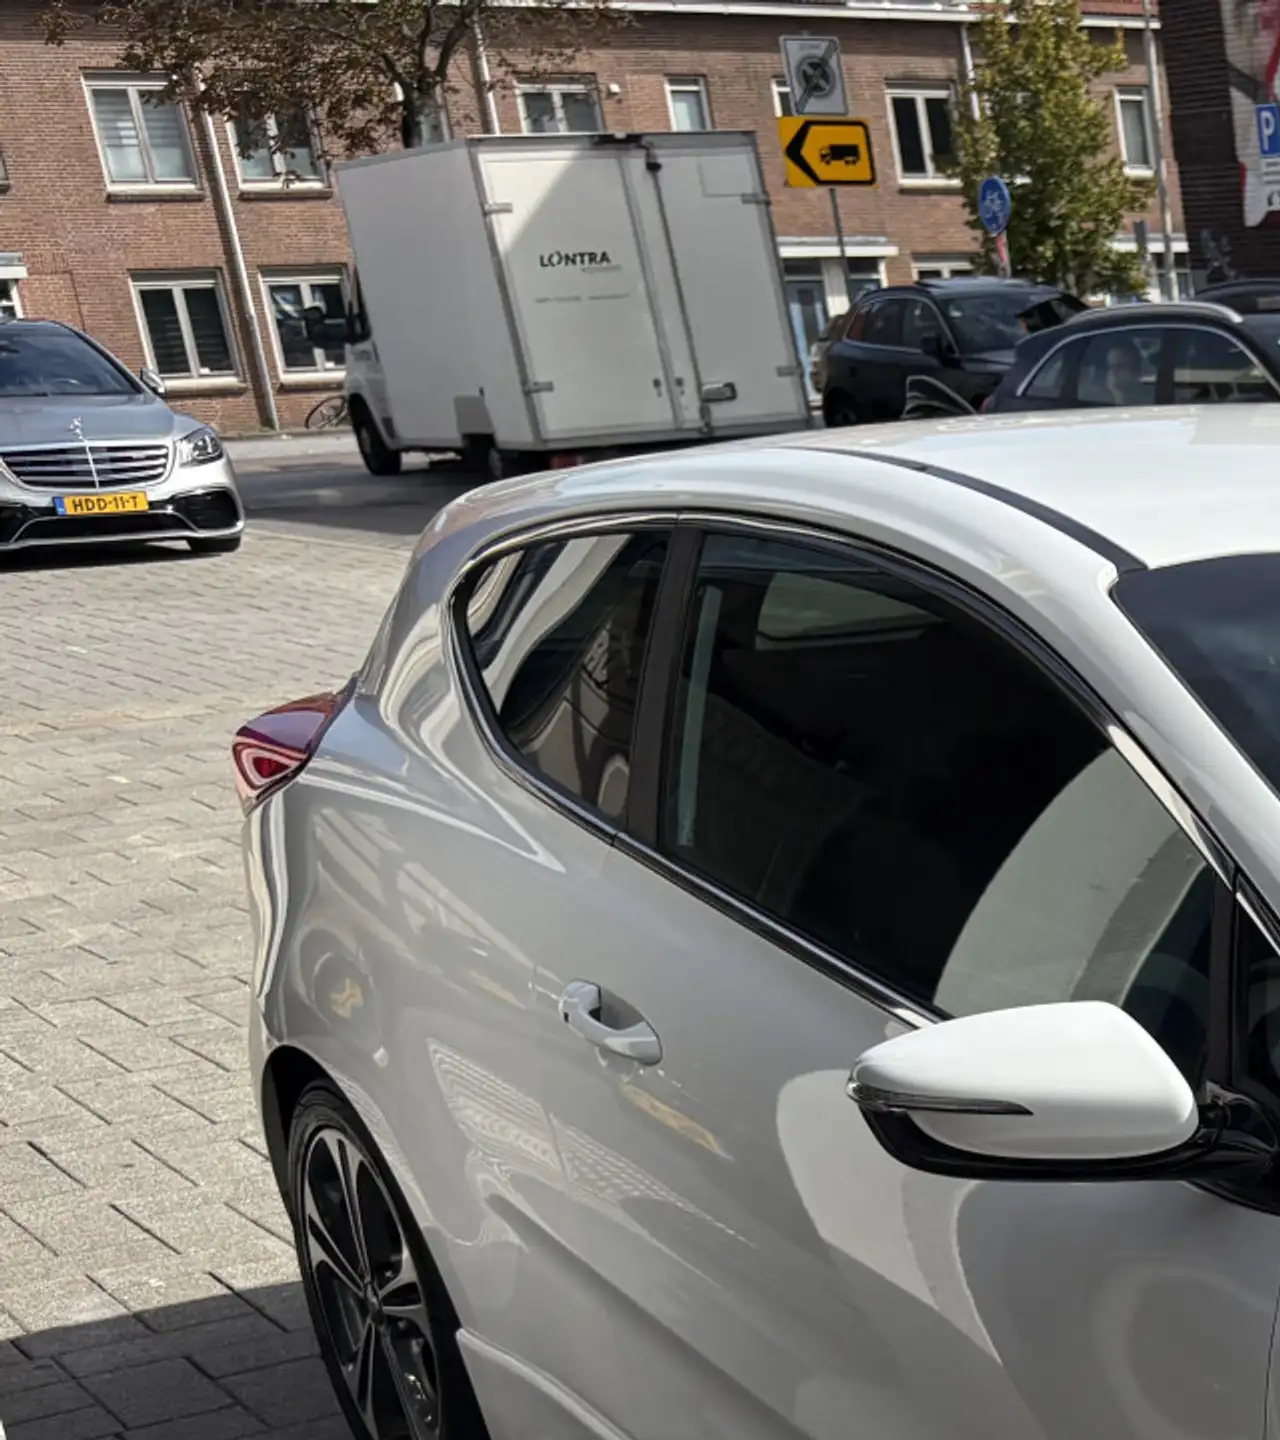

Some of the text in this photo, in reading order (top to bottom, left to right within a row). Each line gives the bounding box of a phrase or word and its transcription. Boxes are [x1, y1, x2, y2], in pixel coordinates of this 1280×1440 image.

[1260, 110, 1275, 152] P
[539, 250, 612, 268] LONTRA
[71, 495, 139, 513] HDD-11-T
